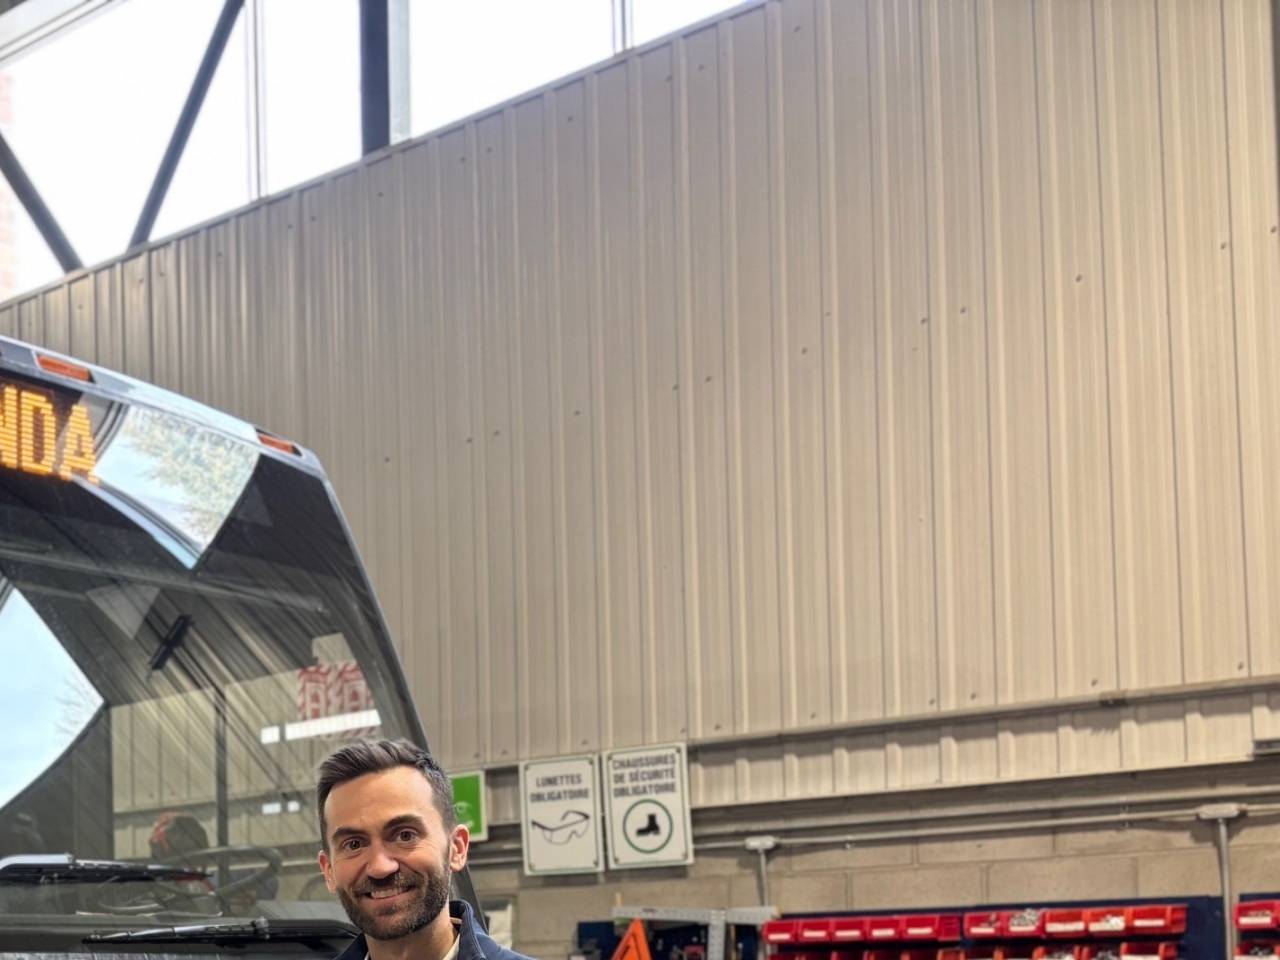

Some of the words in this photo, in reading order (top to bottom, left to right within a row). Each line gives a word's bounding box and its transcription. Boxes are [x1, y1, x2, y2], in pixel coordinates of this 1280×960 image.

[613, 754, 675, 770] CHAUSSURES
[536, 773, 582, 787] LUNETTES
[614, 773, 625, 784] DE
[530, 788, 589, 802] OBLIGATOIRE
[613, 783, 675, 797] OBLIGATOIRE
